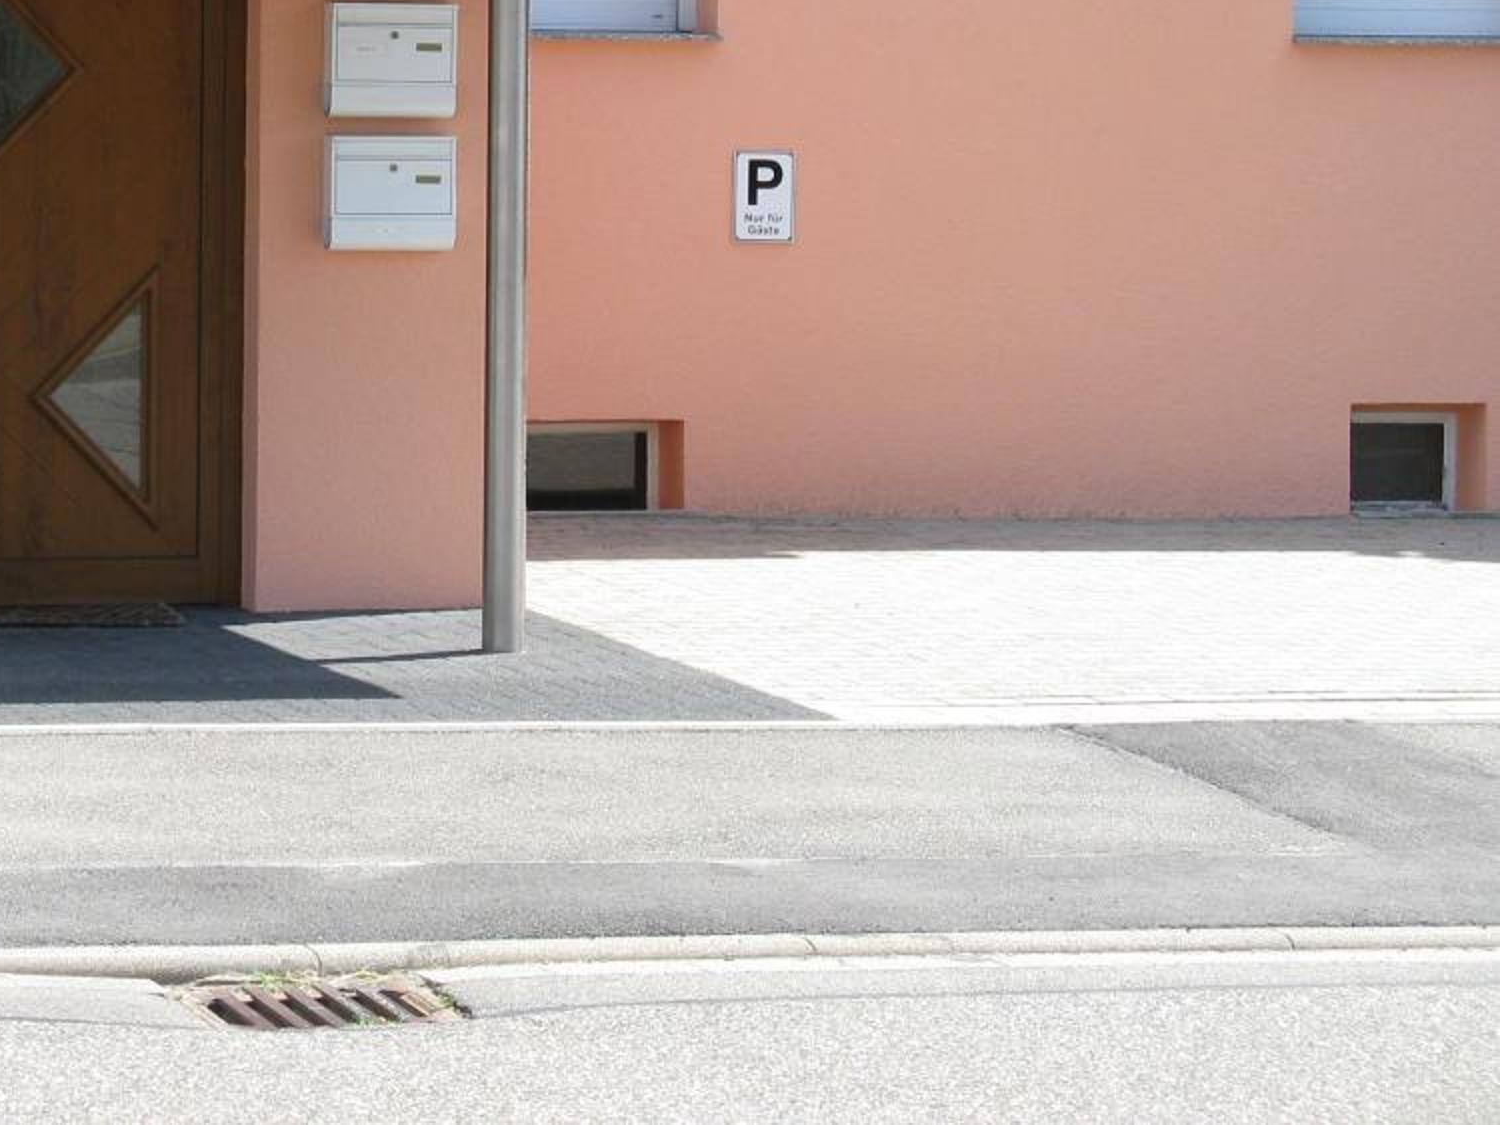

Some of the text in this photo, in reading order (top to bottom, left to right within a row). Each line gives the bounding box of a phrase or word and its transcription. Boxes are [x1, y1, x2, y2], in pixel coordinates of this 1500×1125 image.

[747, 159, 783, 206] P
[743, 213, 783, 223] Nur für
[747, 225, 780, 235] Gäste
